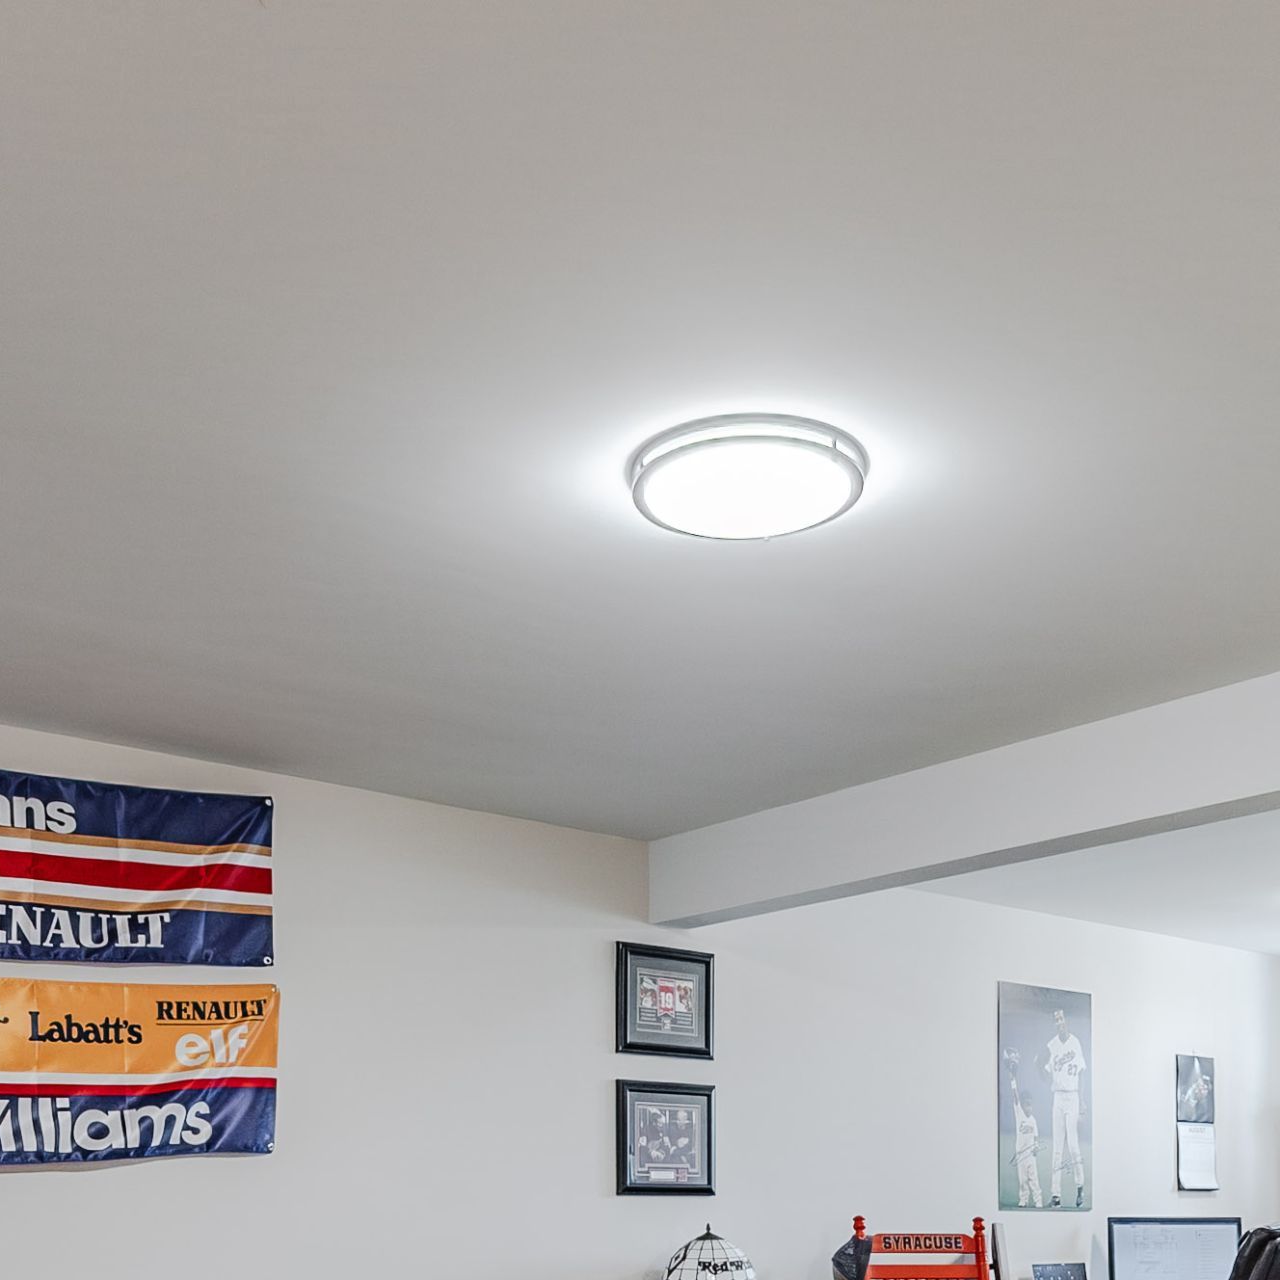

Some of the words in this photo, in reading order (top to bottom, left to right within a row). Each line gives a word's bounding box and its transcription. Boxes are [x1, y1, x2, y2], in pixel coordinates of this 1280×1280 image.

[156, 998, 267, 1021] RENAULT
[28, 1011, 143, 1045] Labatt's
[175, 1024, 249, 1066] elf
[882, 1236, 963, 1250] SYRACUSE
[698, 1260, 729, 1275] Red
